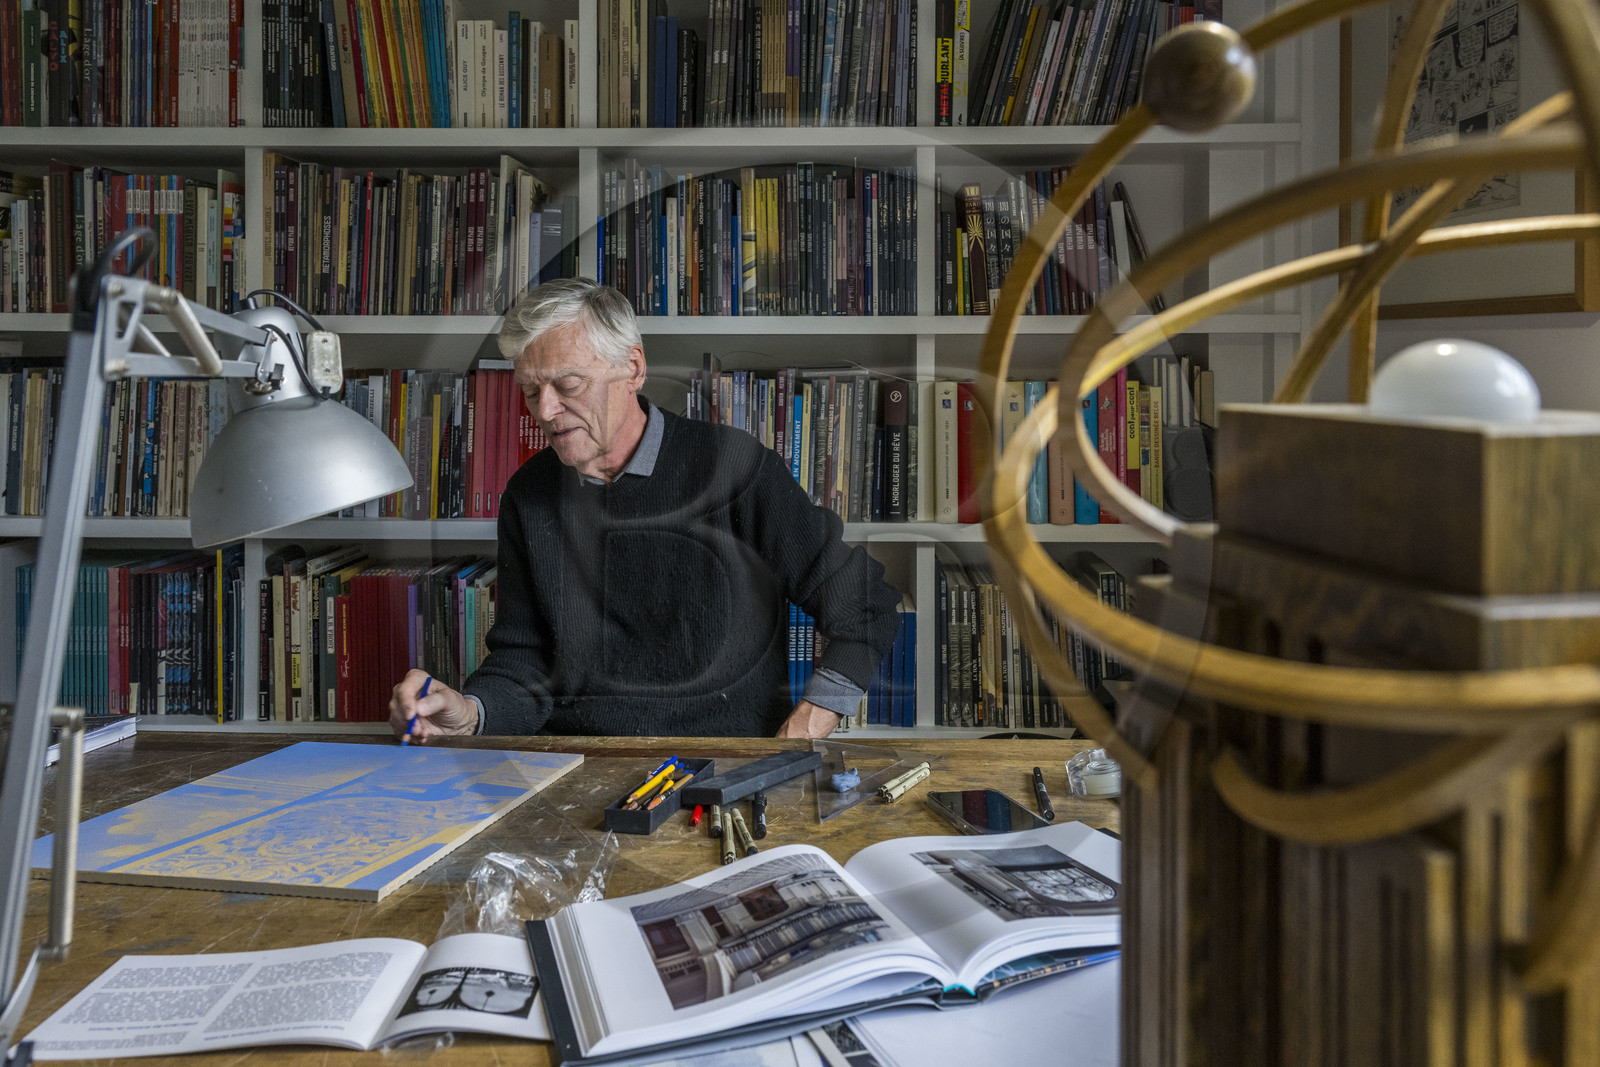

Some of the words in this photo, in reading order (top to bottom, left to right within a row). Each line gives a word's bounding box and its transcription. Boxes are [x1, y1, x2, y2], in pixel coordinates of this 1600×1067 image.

[48, 21, 58, 72] CALVO
[322, 215, 332, 274] METAMORPHOSES
[442, 423, 450, 458] SCHUITEN
[890, 432, 900, 451] RÊVE
[892, 453, 900, 463] DU
[892, 464, 900, 506] L'HORLOGER
